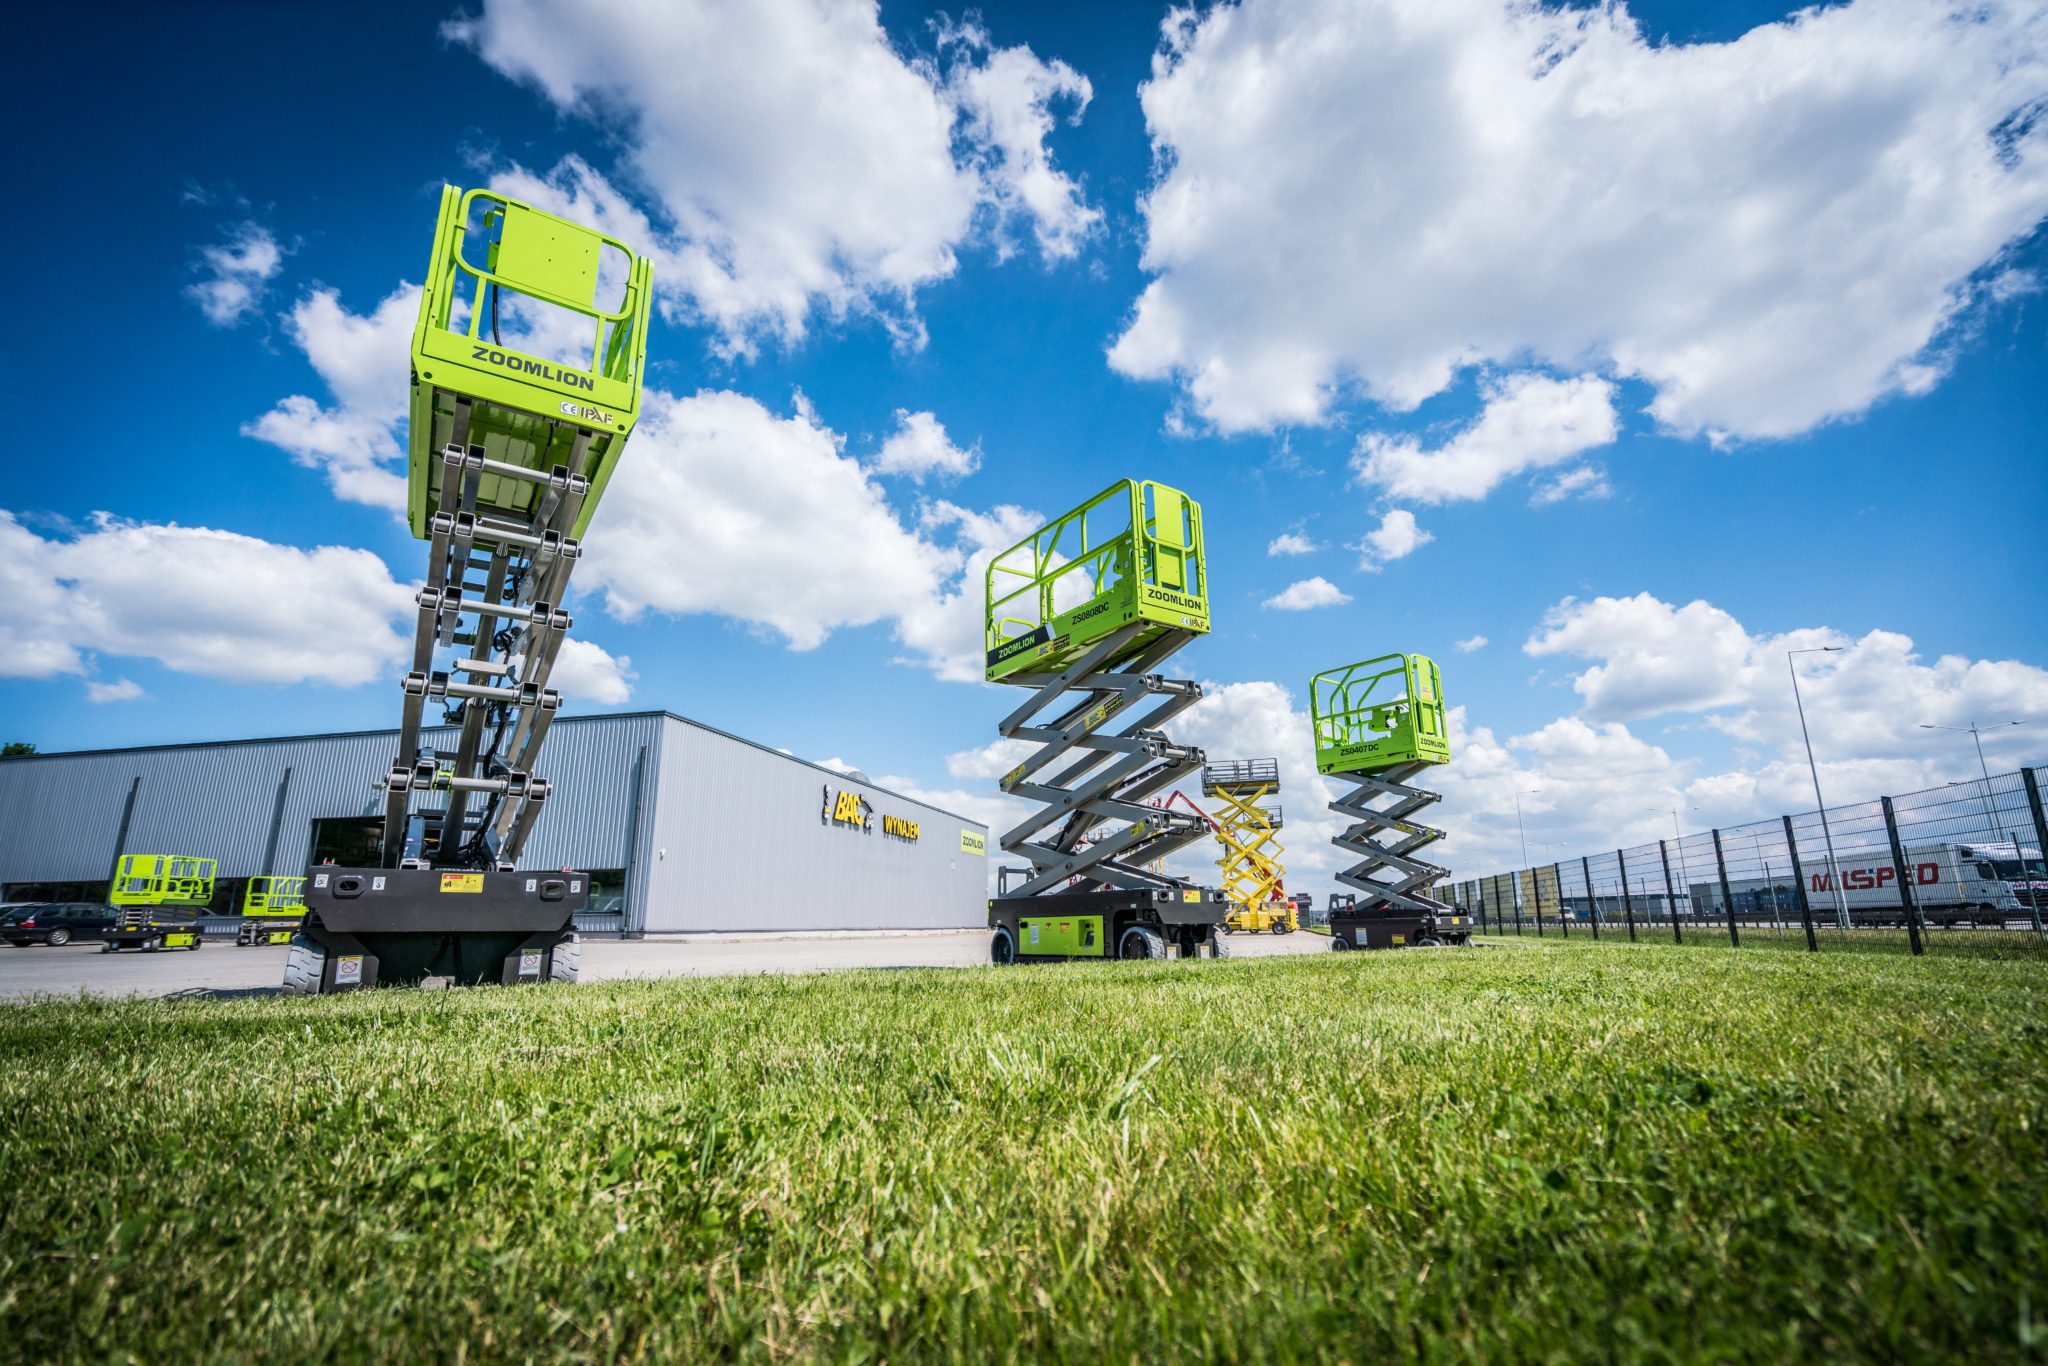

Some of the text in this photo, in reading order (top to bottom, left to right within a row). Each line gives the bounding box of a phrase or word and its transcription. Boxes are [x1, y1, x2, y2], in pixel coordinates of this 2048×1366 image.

[472, 346, 594, 391] ZOOMLION
[562, 403, 576, 415] CE
[580, 406, 613, 424] IPAF
[1148, 588, 1201, 610] ZOOMLION
[1072, 601, 1109, 625] ZS0808DC
[999, 635, 1035, 659] ZOOMLION
[1340, 744, 1380, 756] ZS0407DC
[1420, 738, 1446, 749] ZOOMLION
[834, 790, 920, 839] BAC WYNAJEM
[1812, 862, 1939, 892] MLSPED
